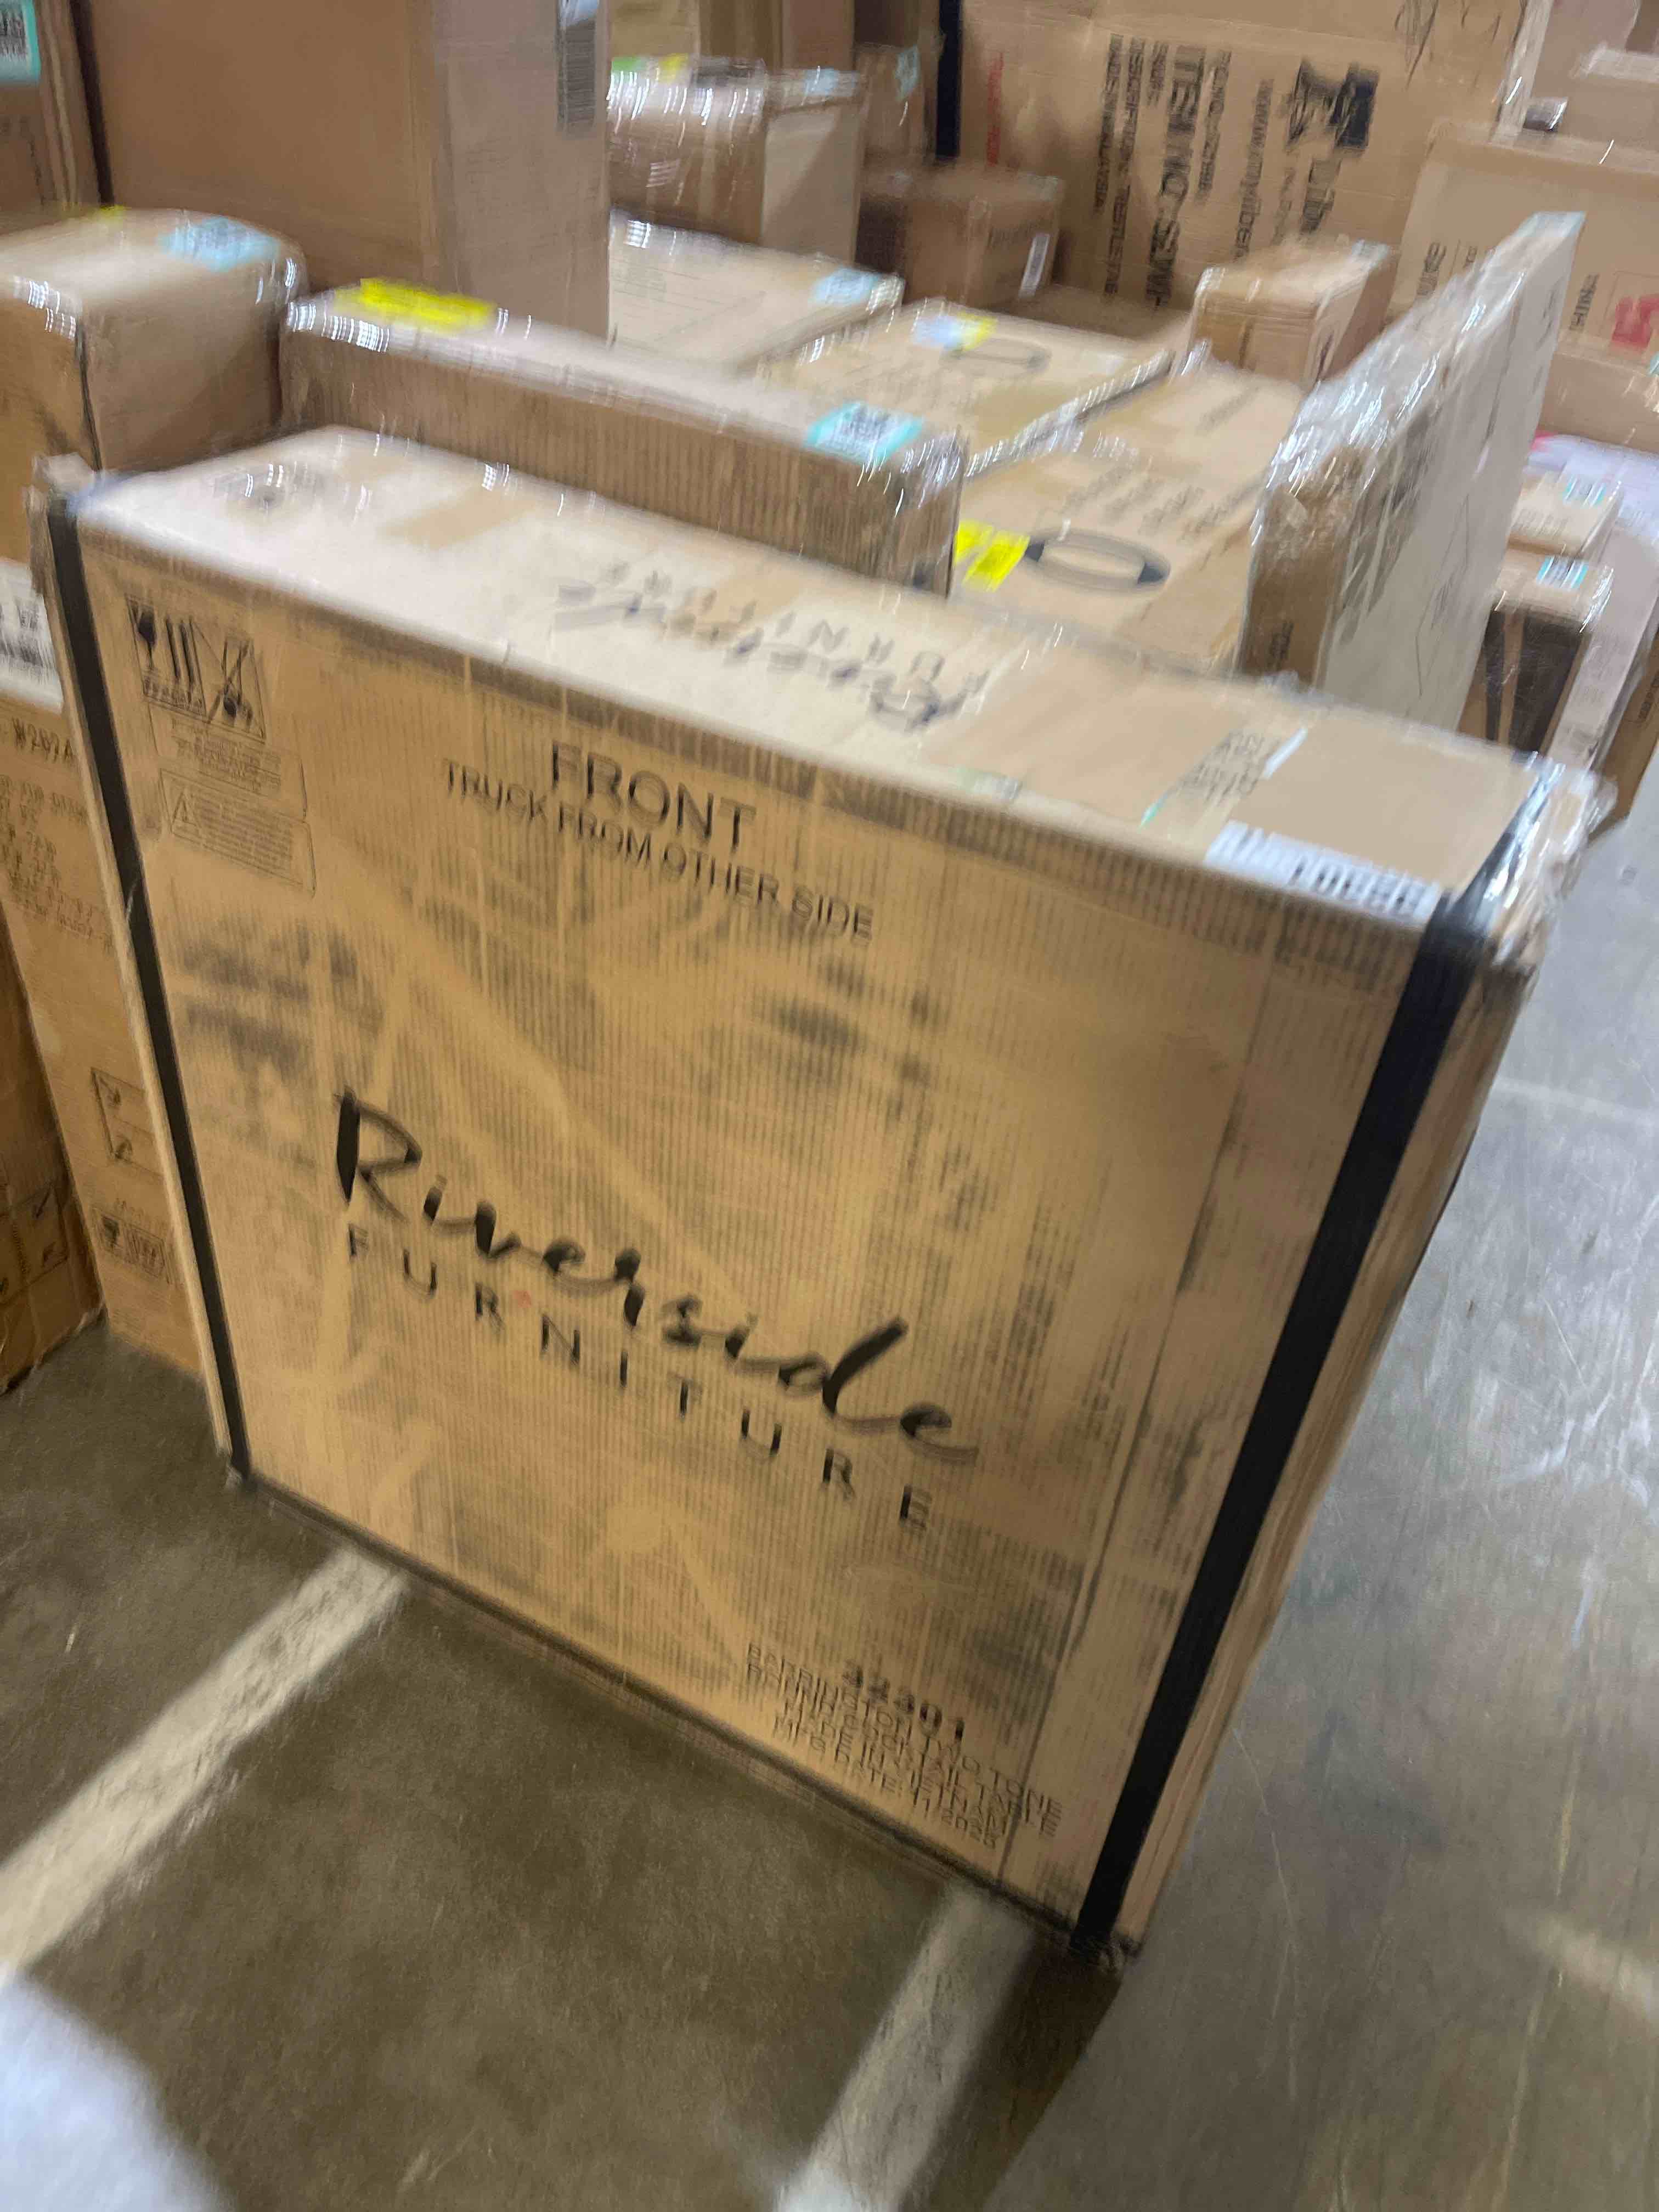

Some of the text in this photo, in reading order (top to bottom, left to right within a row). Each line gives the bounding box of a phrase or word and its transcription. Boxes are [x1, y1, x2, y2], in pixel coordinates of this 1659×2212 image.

[443, 758, 873, 946] TRUCK FROM OTHER SIDE
[551, 741, 756, 854] FRONT
[347, 1222, 933, 1532] FURNITURE
